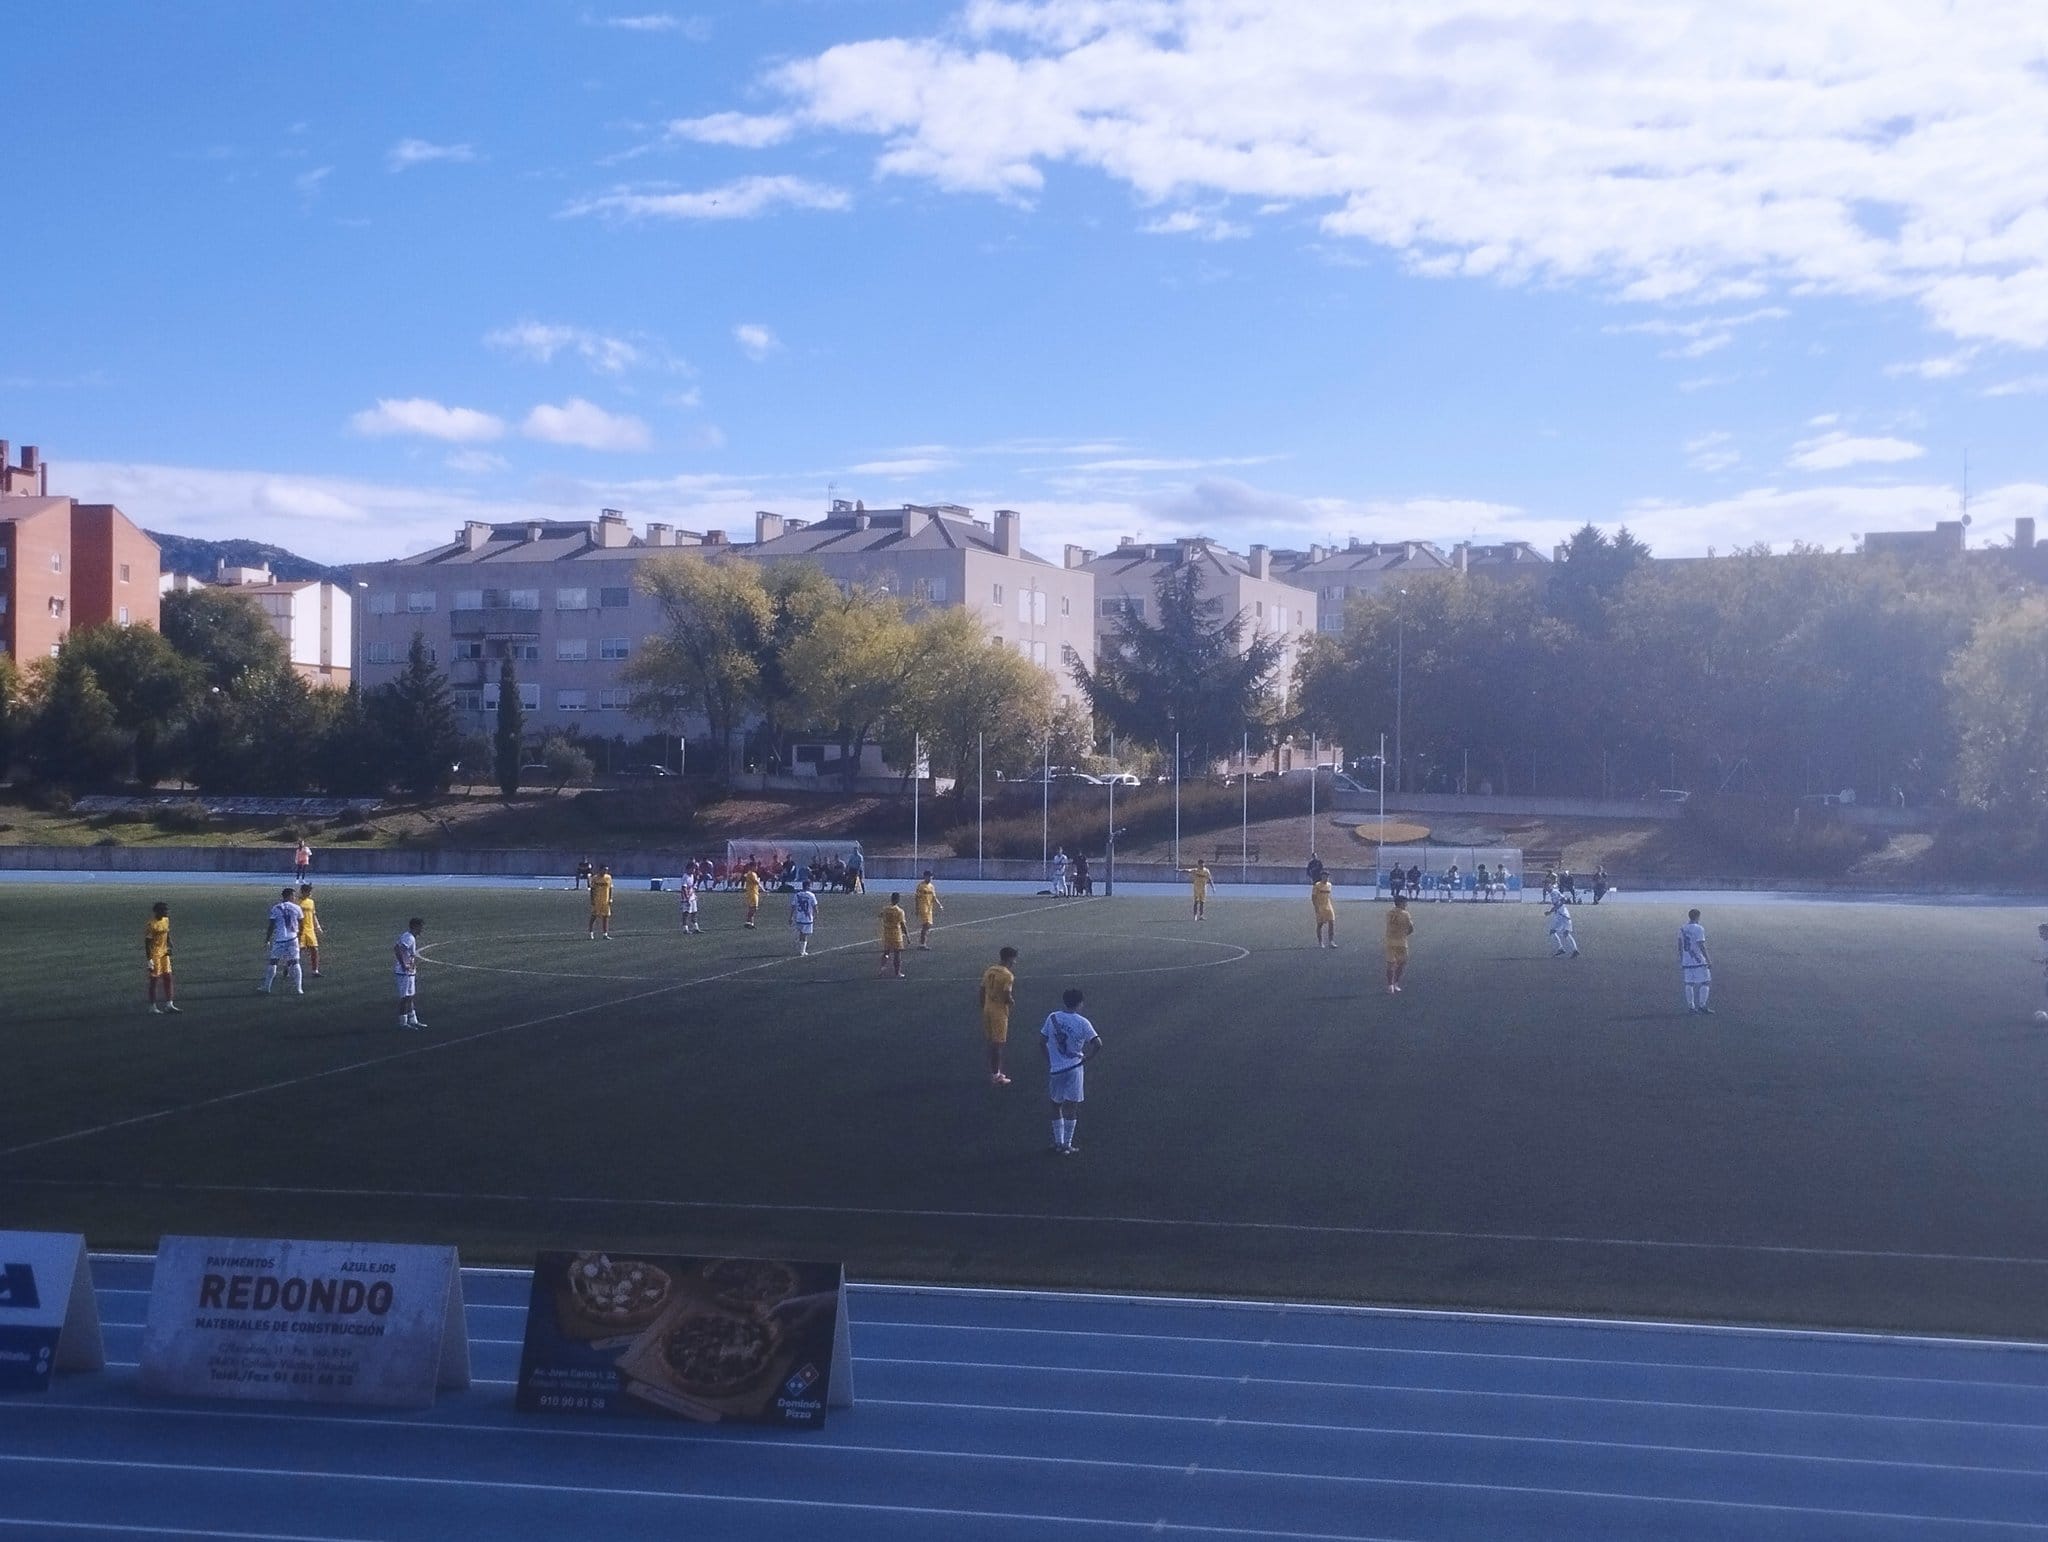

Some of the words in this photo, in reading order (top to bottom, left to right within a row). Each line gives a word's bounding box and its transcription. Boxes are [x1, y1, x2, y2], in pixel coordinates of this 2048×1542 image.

[206, 1256, 275, 1269] PAVIMENTOS
[340, 1262, 396, 1273] AZULEJOS
[199, 1275, 394, 1315] REDONDO
[195, 1317, 270, 1332] MATERIALES
[272, 1320, 289, 1333] DE
[290, 1320, 385, 1337] CONSTRUCCIÓN
[273, 1371, 287, 1383] 91
[777, 1398, 821, 1409] Domino's
[785, 1408, 811, 1419] Pizza
